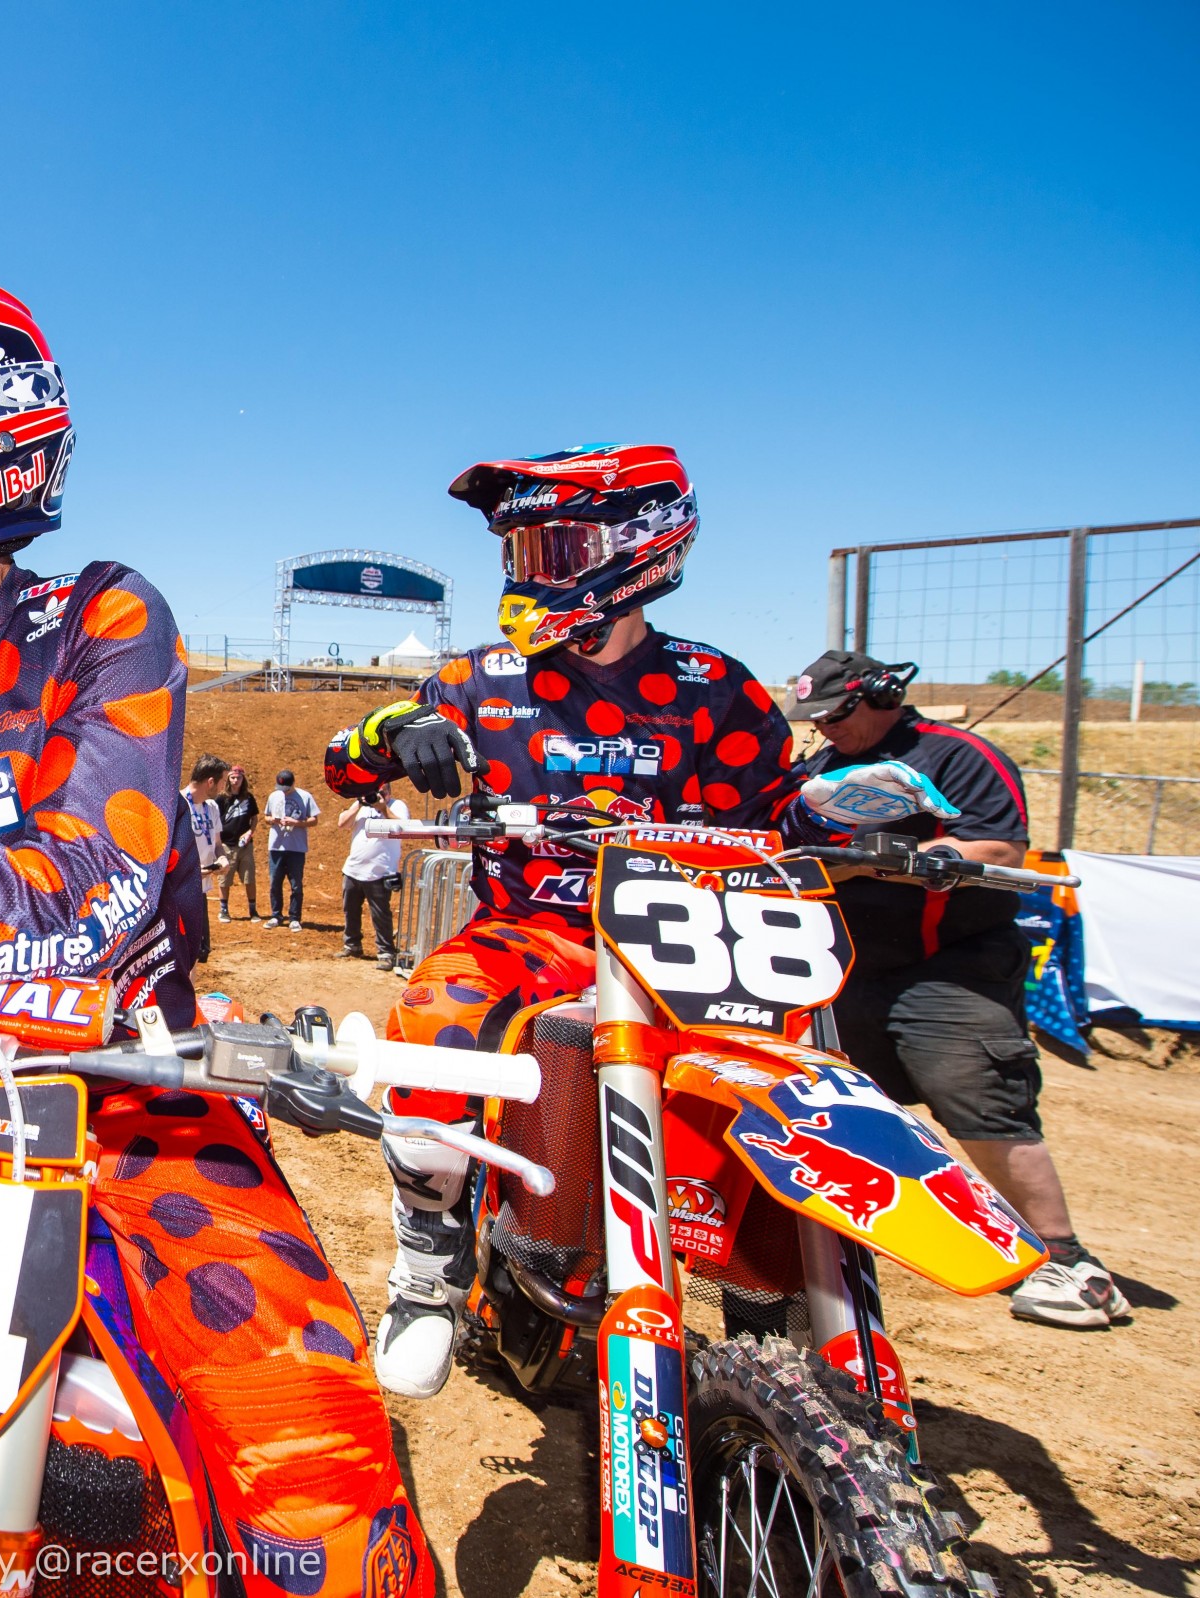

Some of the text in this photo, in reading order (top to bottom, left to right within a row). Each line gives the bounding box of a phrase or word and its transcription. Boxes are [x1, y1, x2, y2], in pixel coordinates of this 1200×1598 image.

[3, 449, 46, 503] Bull
[613, 550, 677, 606] Red Bull
[487, 652, 526, 671] PPG
[511, 704, 541, 717] bakery
[545, 738, 662, 759] GoPro
[635, 829, 774, 851] RENTHAL
[613, 879, 845, 1006] 38
[704, 1000, 774, 1027] KTM
[63, 1029, 88, 1038] ENGLAND
[670, 1236, 721, 1256] ROOF
[615, 1320, 681, 1343] OAKLEY
[612, 1411, 632, 1519] MOTOREX
